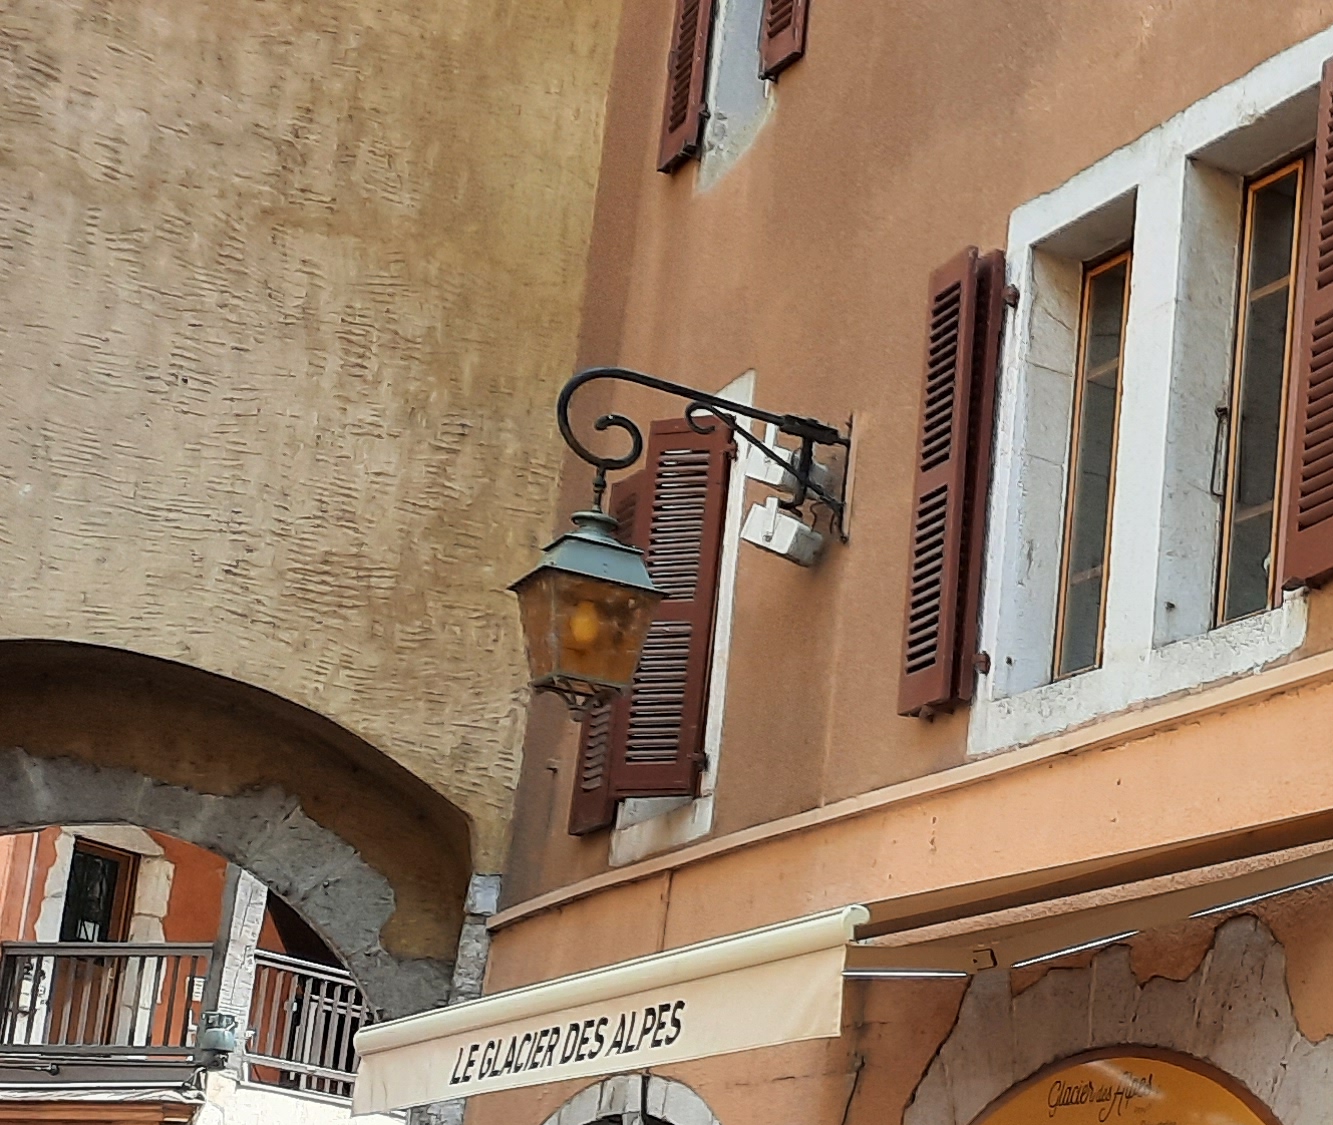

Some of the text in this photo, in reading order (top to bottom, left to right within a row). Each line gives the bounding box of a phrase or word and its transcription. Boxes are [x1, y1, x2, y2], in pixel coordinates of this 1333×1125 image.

[449, 1000, 685, 1085] LE GLACIER DES ALPES
[1048, 1081, 1094, 1117] Glacier
